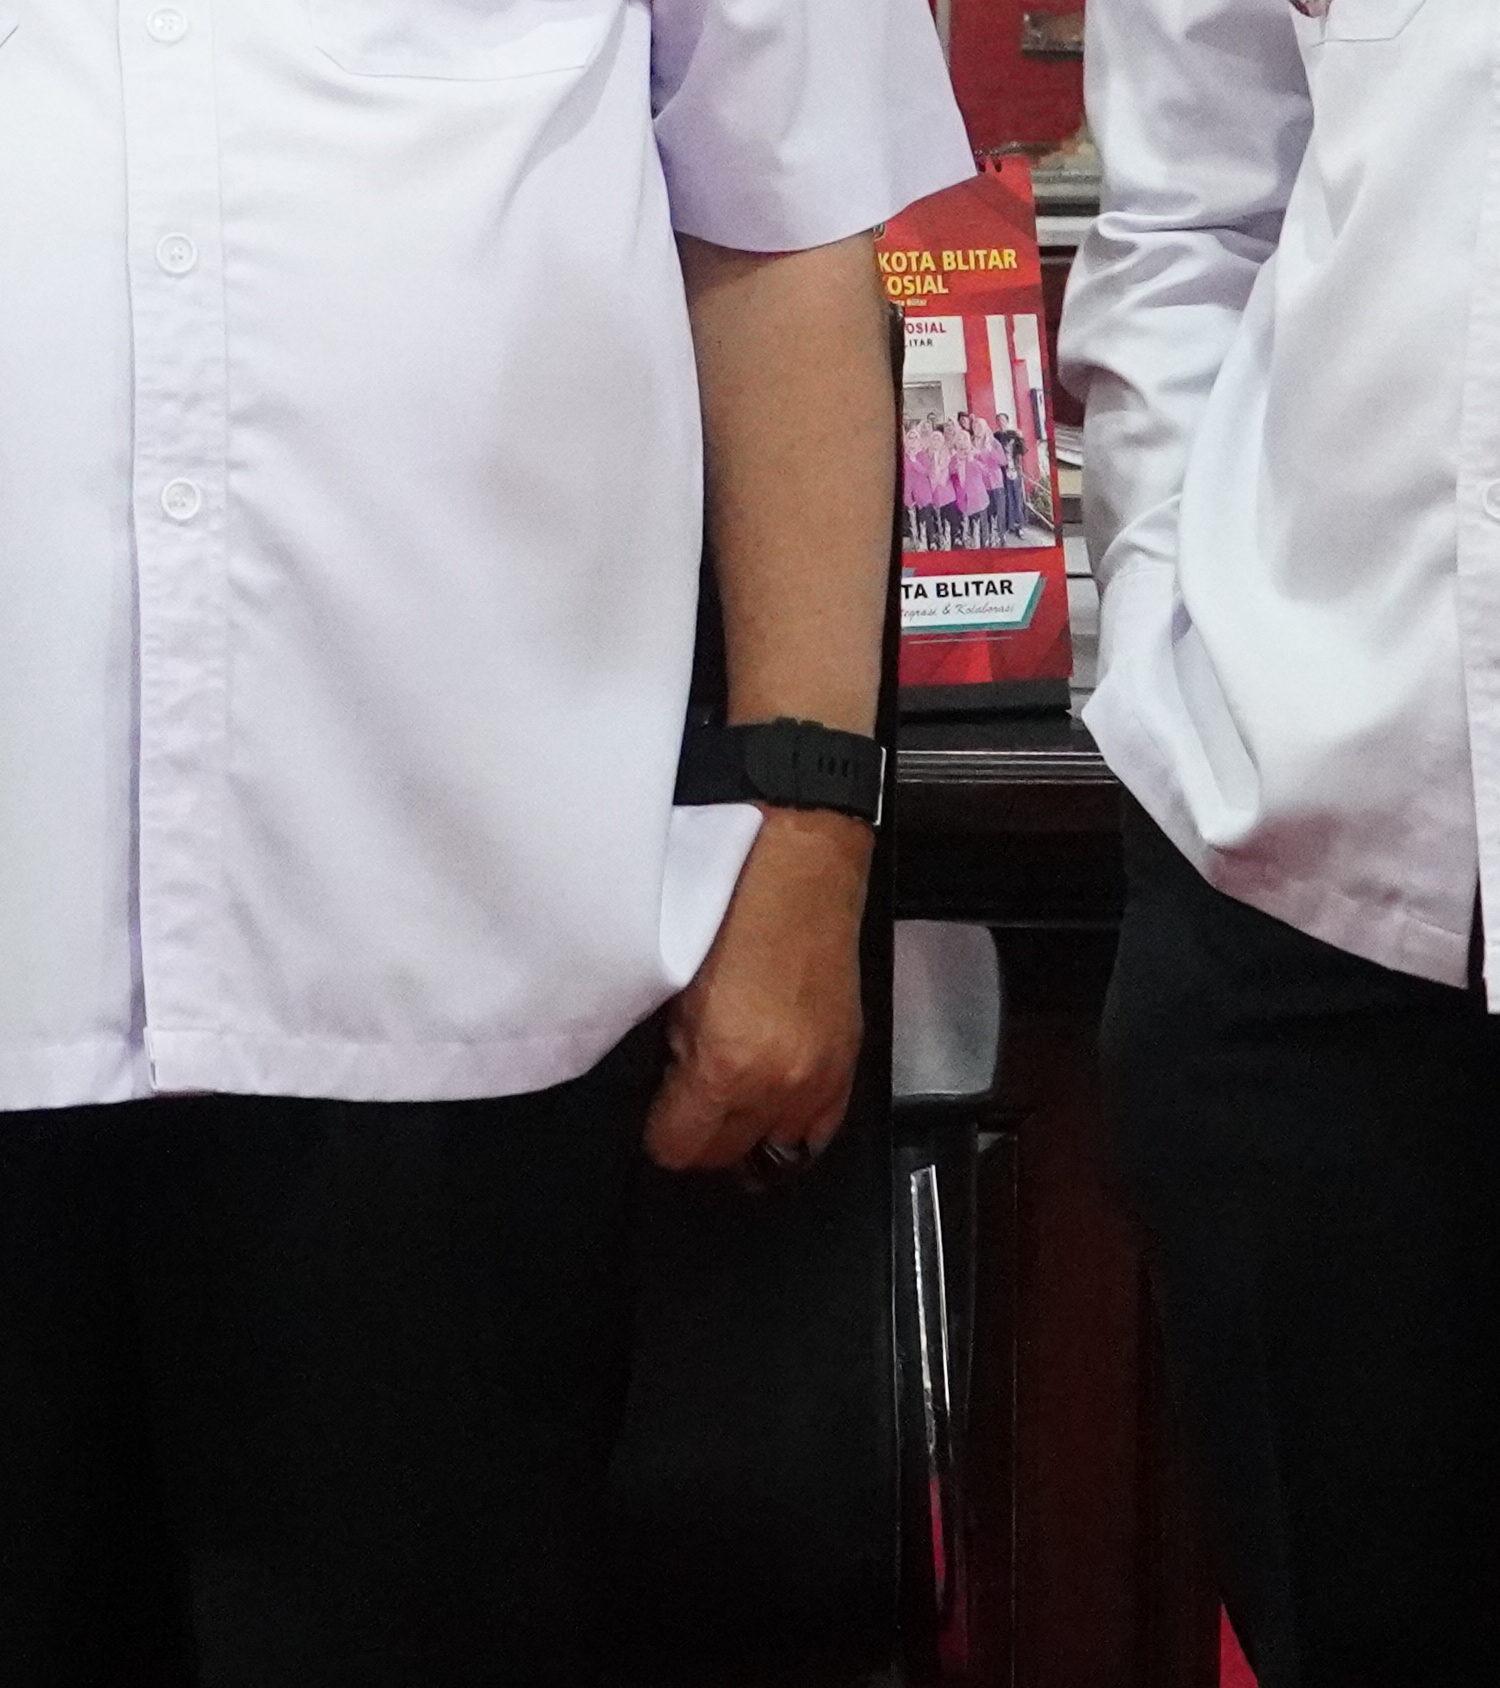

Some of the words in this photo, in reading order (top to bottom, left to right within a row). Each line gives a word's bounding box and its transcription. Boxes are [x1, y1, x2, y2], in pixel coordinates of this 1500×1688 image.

[878, 251, 936, 273] KOTA
[942, 248, 1017, 271] BLITAR
[885, 274, 949, 296] OSIAL
[936, 579, 1014, 598] BLITAR
